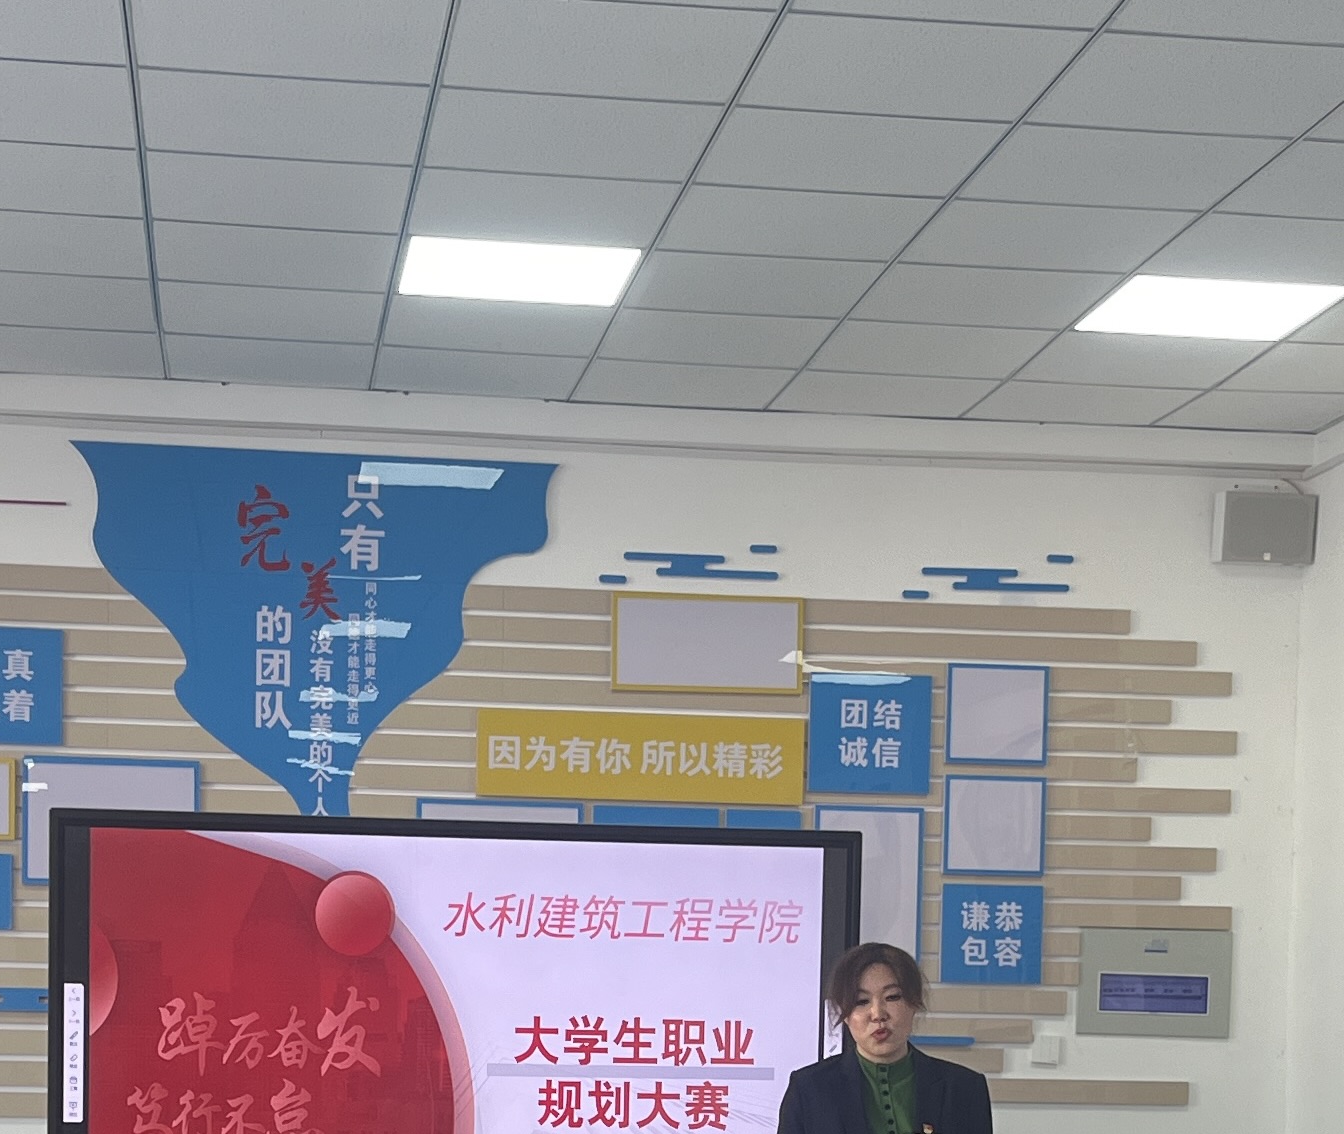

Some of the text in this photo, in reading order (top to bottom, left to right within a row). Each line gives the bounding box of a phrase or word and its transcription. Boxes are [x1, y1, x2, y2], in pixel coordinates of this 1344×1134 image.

[340, 474, 386, 572] 只有
[255, 605, 293, 731] 的团队
[308, 629, 335, 816] 没有完美的个人
[840, 698, 903, 730] 团结
[488, 735, 784, 780] 因为有你 所以精彩
[838, 736, 902, 768] 诚信
[443, 891, 804, 944] 水利建筑工程学院
[960, 901, 1024, 932] 谦恭
[960, 936, 1022, 967] 包容
[157, 985, 382, 1078] 踔厉奋发
[513, 1014, 755, 1067] 大学生职业
[537, 1078, 730, 1131] 规划大赛
